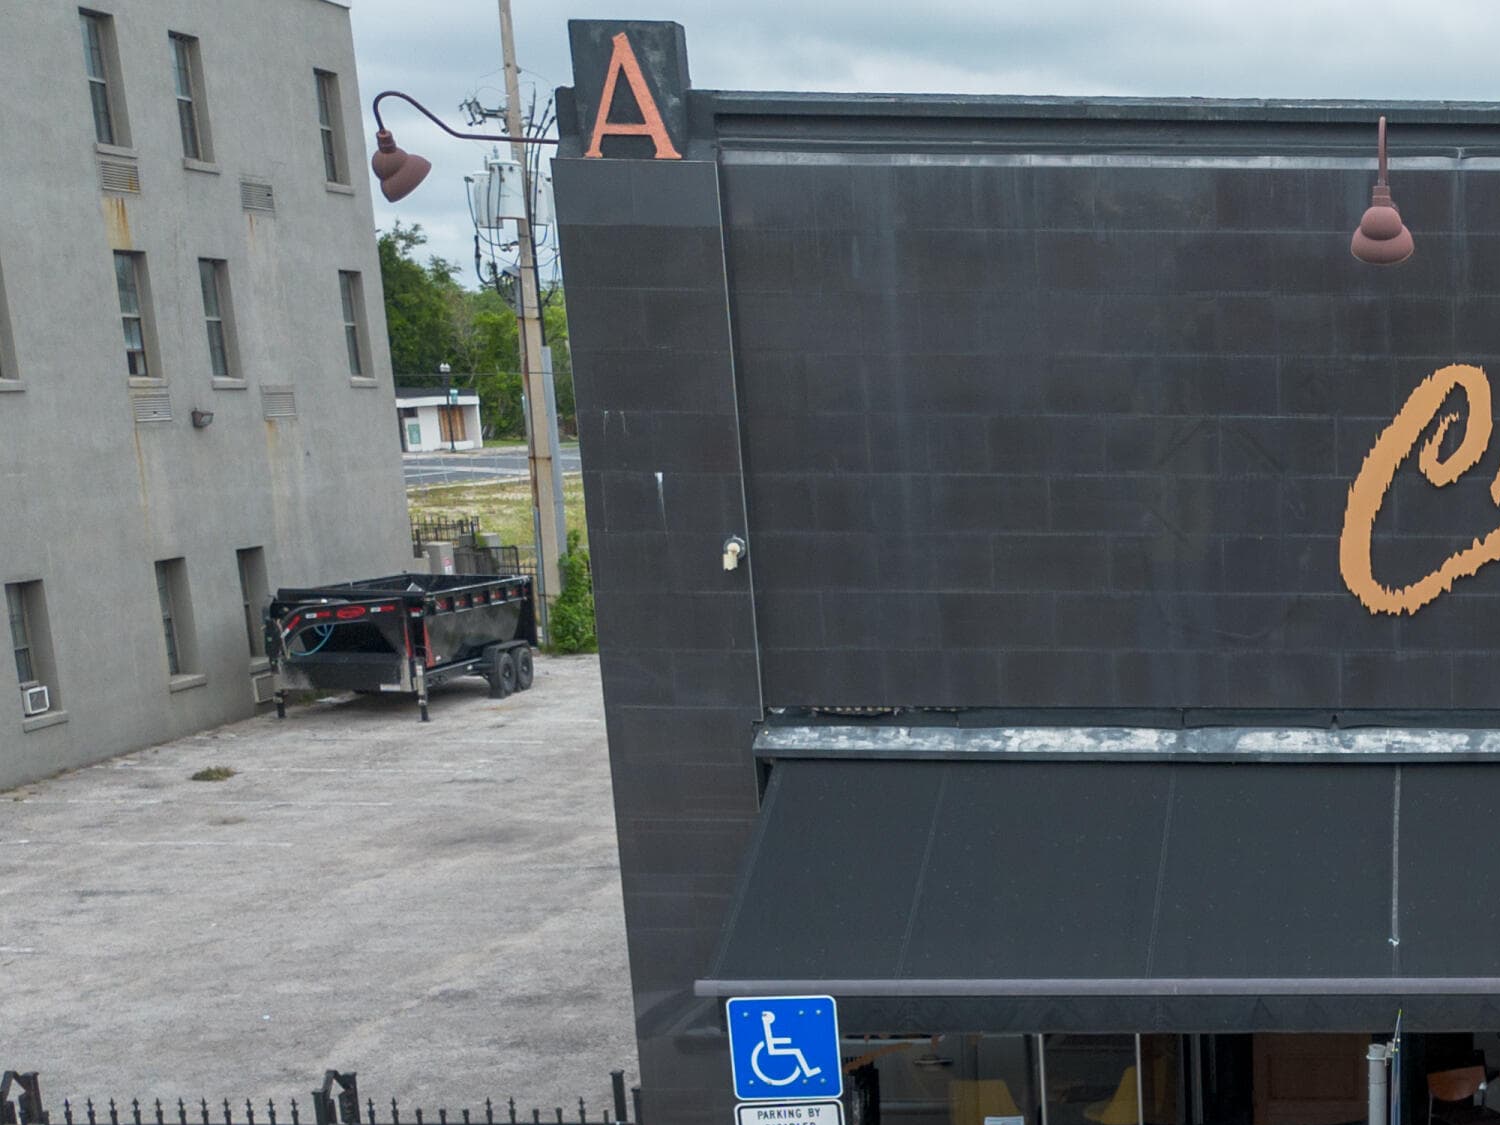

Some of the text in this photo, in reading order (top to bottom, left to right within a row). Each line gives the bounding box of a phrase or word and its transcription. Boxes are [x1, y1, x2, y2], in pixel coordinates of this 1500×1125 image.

[584, 31, 682, 159] A
[757, 1108, 821, 1120] PARKING BY
